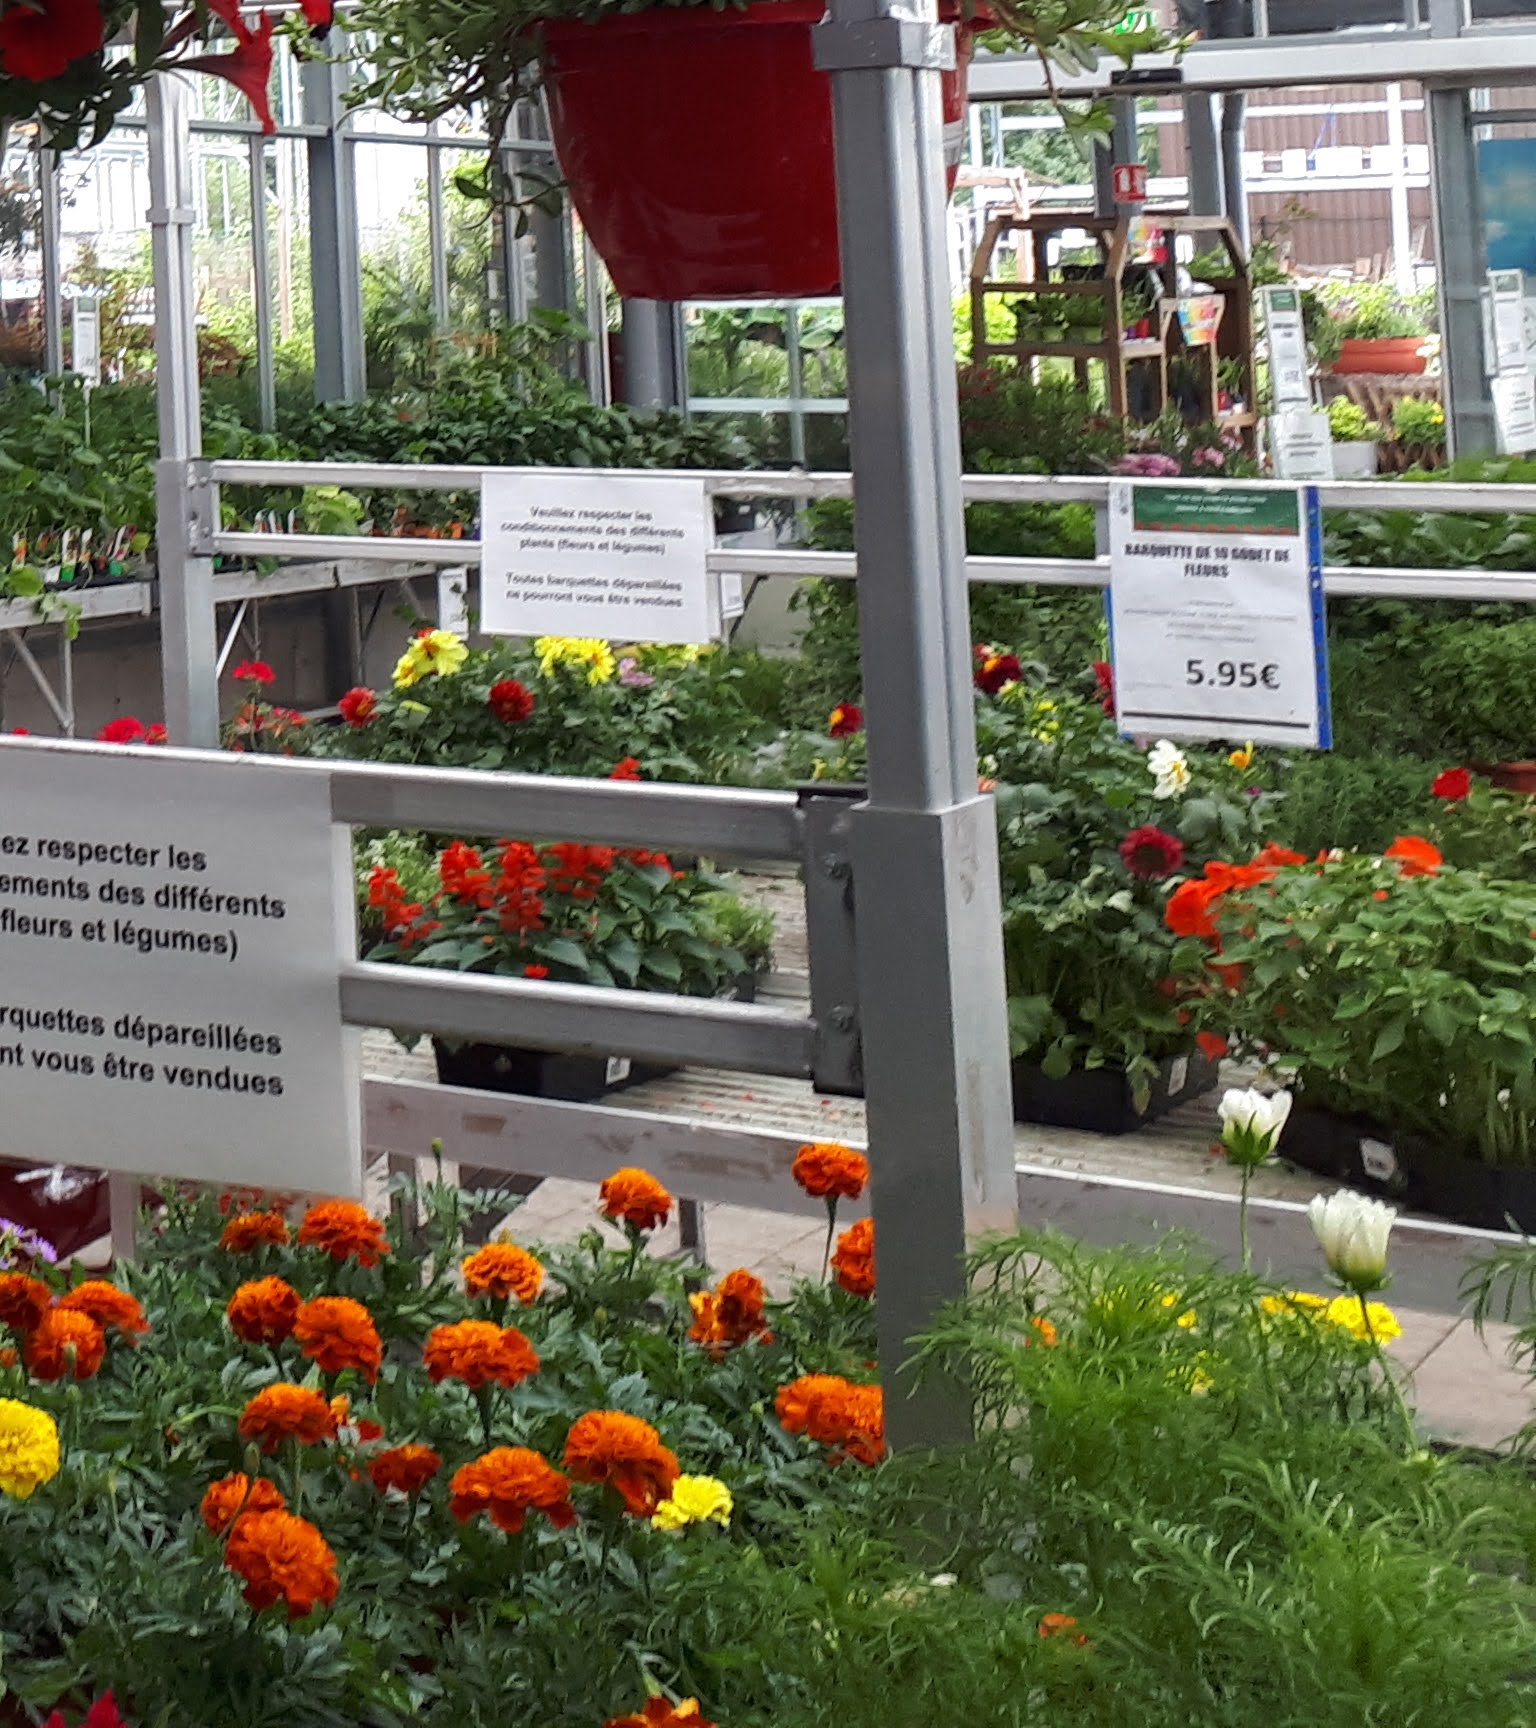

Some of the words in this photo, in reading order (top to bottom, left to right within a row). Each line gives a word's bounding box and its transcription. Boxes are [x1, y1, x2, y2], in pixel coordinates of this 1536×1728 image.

[1125, 543, 1193, 560] BARQUETTE
[1195, 544, 1212, 560] DE
[1231, 547, 1271, 562] GODET
[1274, 548, 1290, 562] DE
[1183, 564, 1229, 578] FLEURS
[1185, 659, 1280, 689] 5.95€
[38, 837, 159, 870] respecter
[168, 845, 207, 872] les
[98, 879, 145, 906] des
[154, 883, 286, 919] différents
[81, 921, 107, 943] et
[114, 920, 238, 960] légumes)
[114, 1013, 282, 1056] dépareillées
[31, 1050, 94, 1077] vous
[102, 1049, 154, 1082] être
[162, 1063, 284, 1097] vendues
